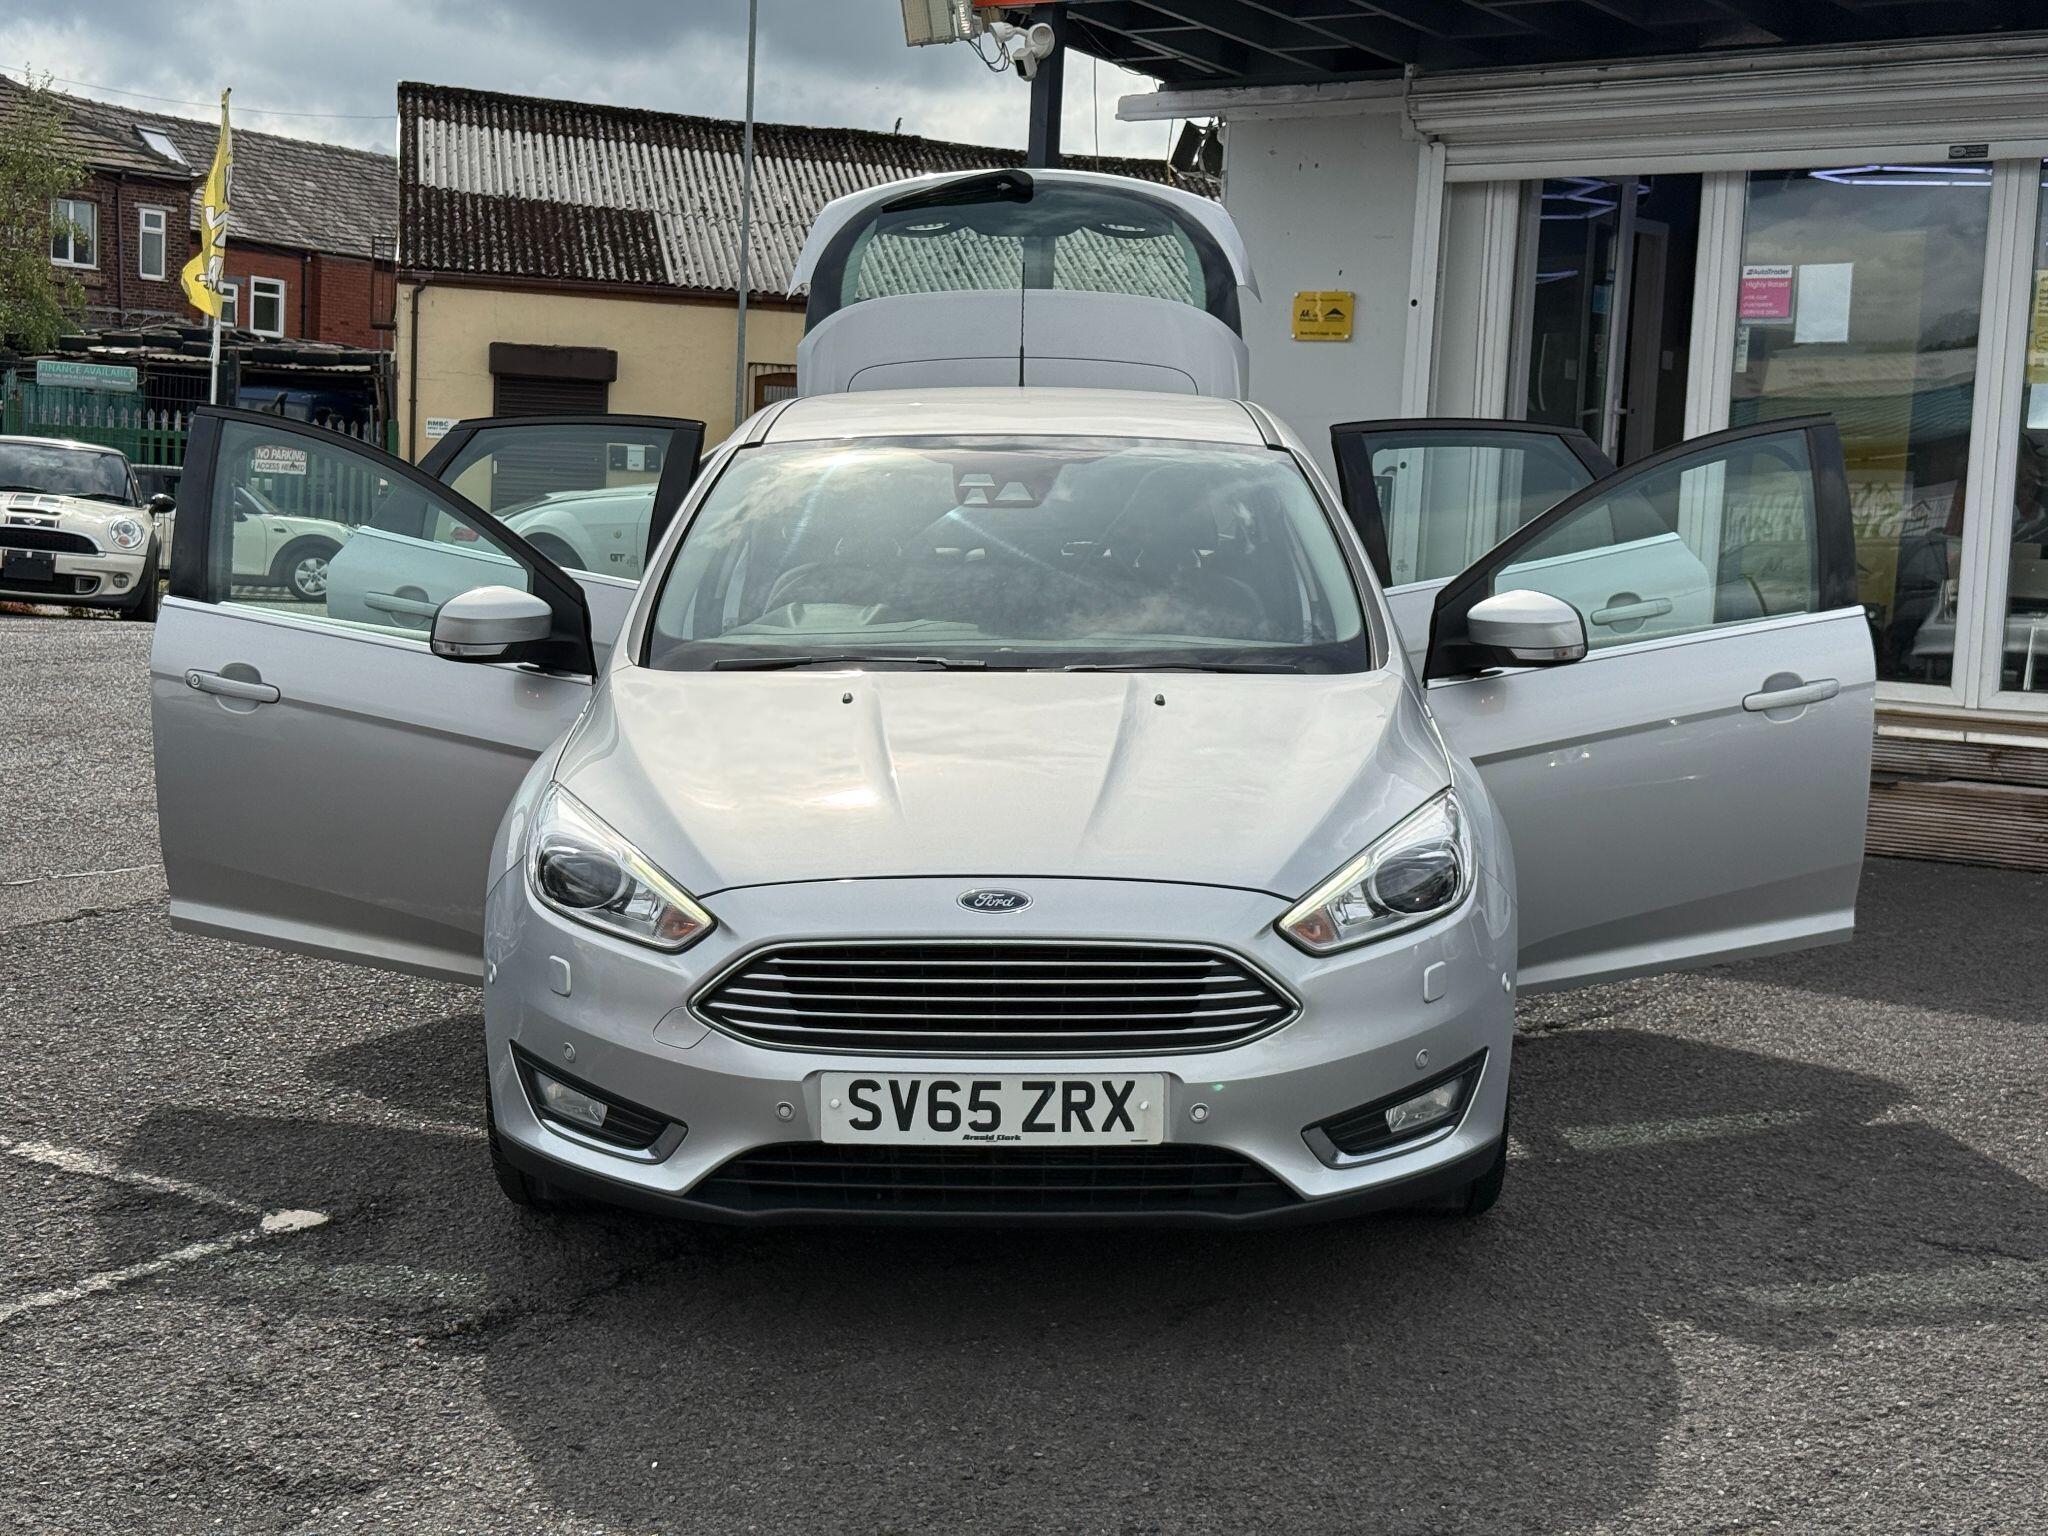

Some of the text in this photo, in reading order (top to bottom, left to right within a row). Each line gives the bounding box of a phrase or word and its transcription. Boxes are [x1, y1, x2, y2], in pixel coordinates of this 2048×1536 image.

[1752, 268, 1789, 276] AutoTrader
[1745, 280, 1788, 290] Highly Rated
[39, 363, 81, 375] FINANCE
[84, 366, 135, 379] AVAILABLE
[256, 448, 306, 462] NO PARKING
[256, 462, 280, 471] ACCESS
[610, 553, 625, 562] GT
[974, 893, 1016, 907] Ford
[848, 1079, 1136, 1133] SV65 ZRX
